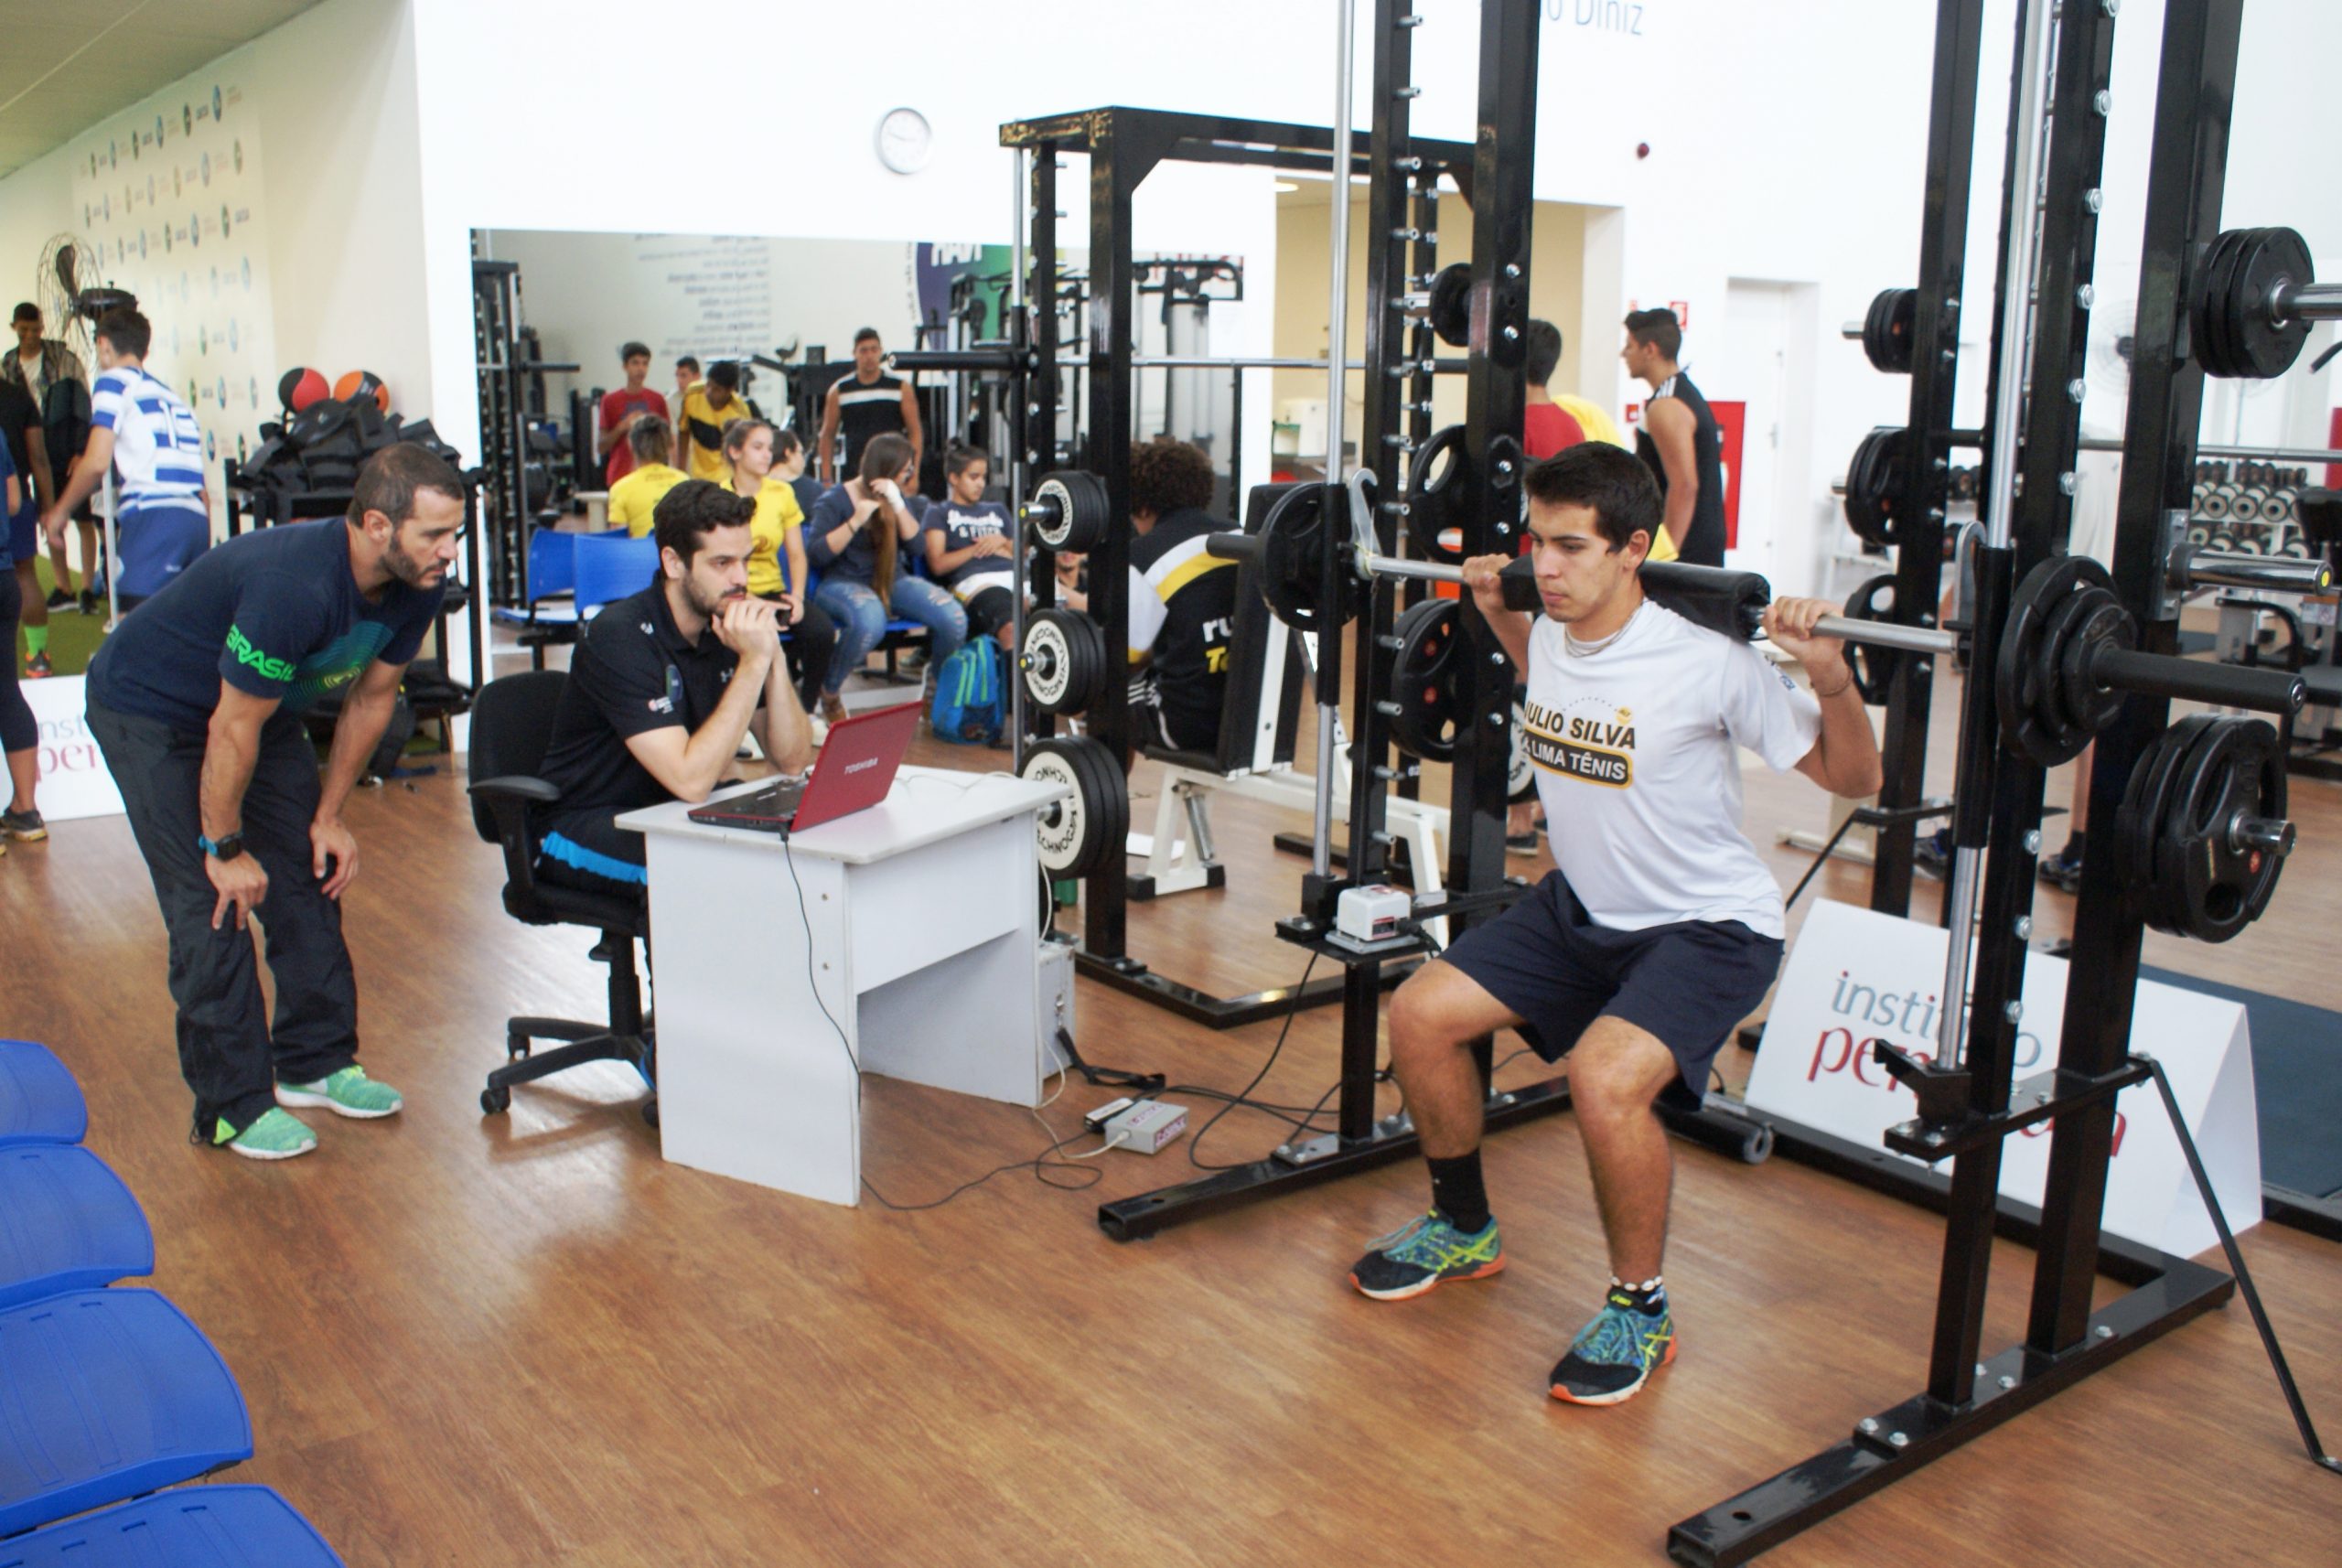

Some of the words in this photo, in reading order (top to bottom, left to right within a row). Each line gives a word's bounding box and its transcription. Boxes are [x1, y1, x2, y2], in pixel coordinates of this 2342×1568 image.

[1574, 0, 1643, 36] Diniz
[226, 623, 296, 682] BRASIL
[1569, 717, 1637, 751] SILVA
[1531, 739, 1567, 768] LIMA
[1569, 751, 1628, 781] TÊNIS
